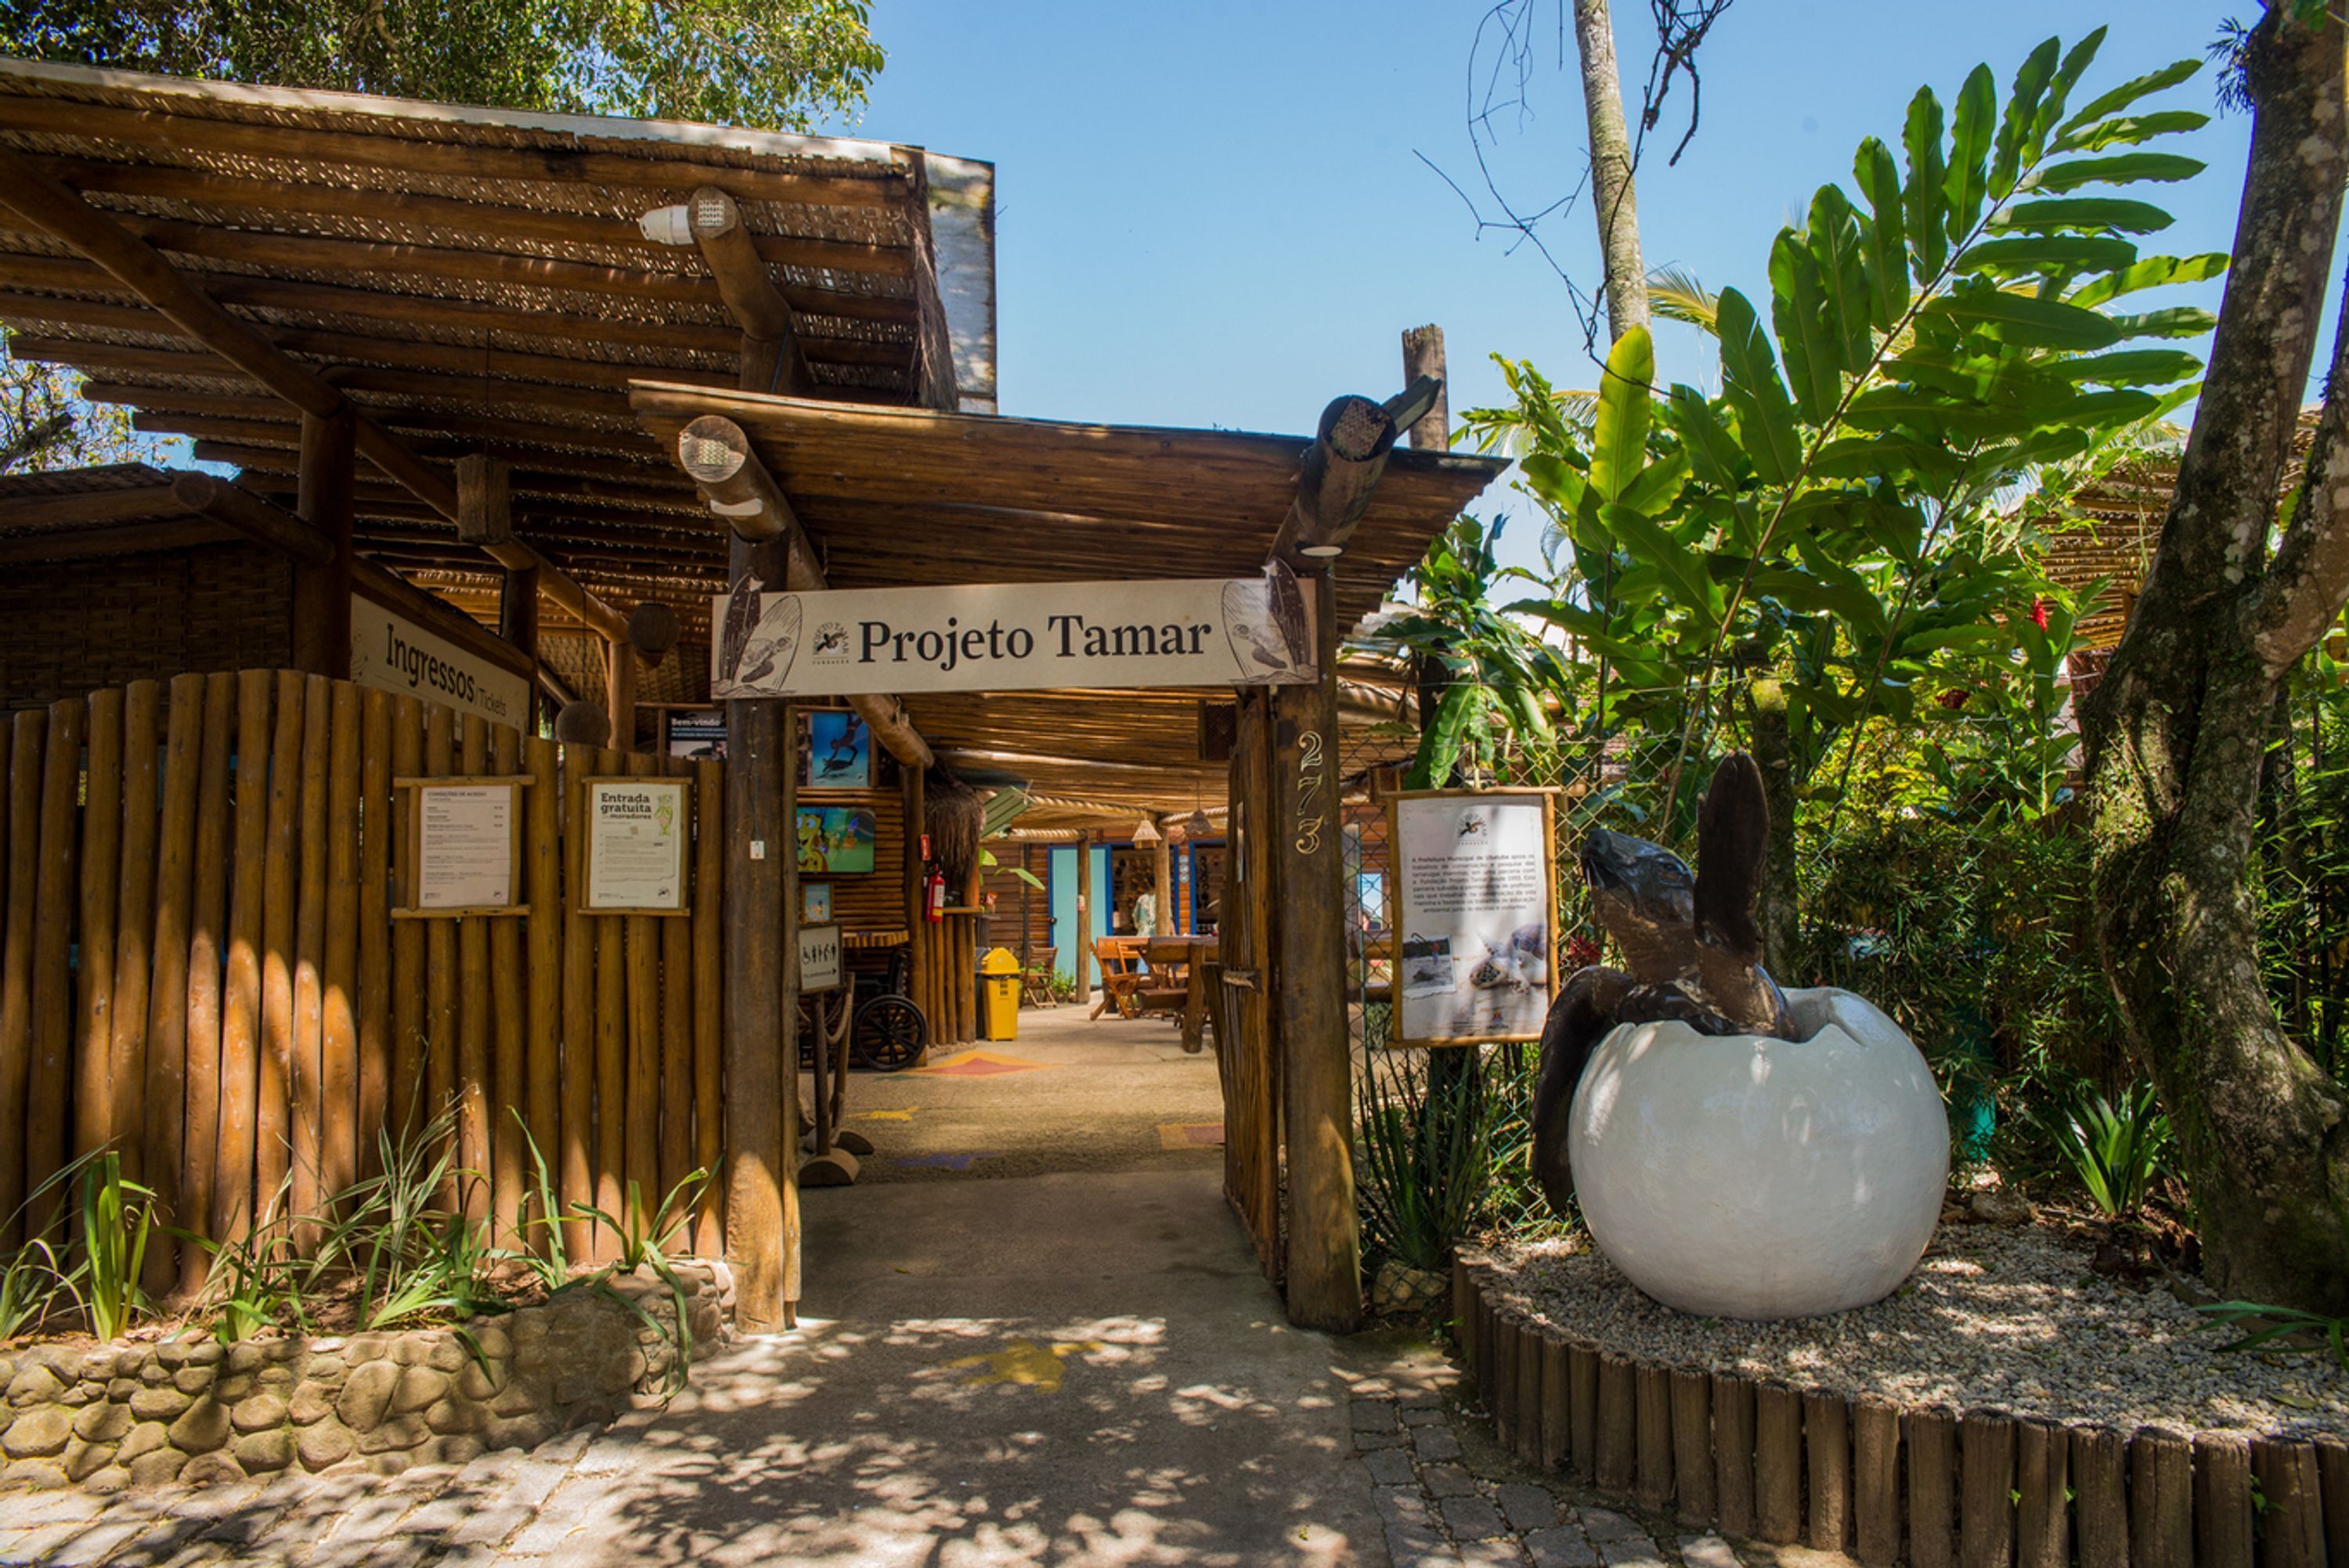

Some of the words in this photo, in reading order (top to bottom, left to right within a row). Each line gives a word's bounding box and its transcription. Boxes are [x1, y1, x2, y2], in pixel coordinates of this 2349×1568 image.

[386, 623, 474, 703] Ingressos
[857, 616, 1033, 672] Projeto
[1048, 615, 1211, 658] Tamar
[601, 792, 650, 802] Entrada
[601, 804, 652, 814] gratuita
[1296, 730, 1323, 855] 273
